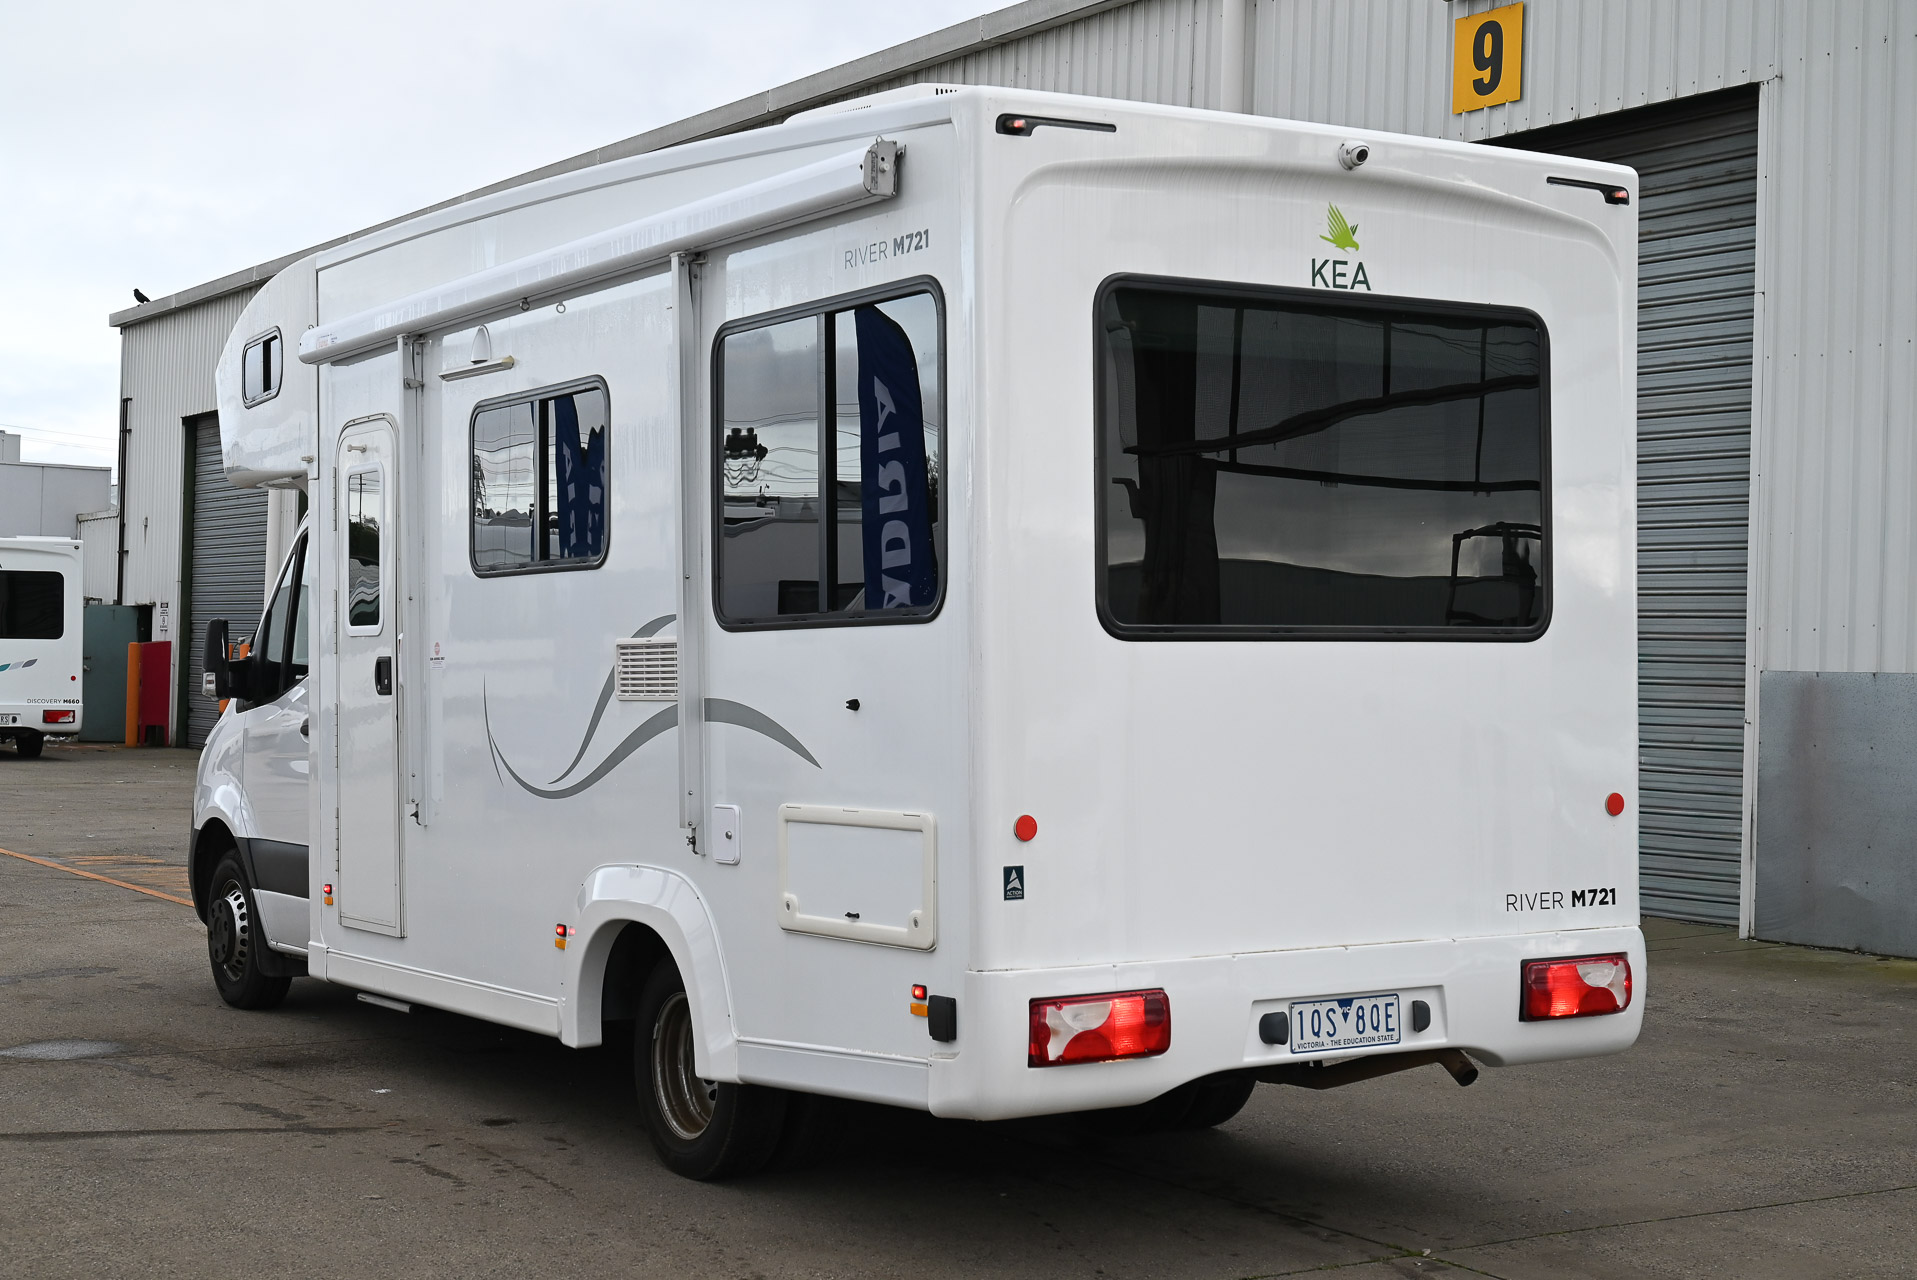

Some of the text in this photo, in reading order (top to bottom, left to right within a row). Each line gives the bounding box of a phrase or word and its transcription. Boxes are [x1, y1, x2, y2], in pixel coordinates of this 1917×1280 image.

[1473, 20, 1503, 96] 9
[844, 228, 929, 270] RIVER M721
[1311, 258, 1371, 291] KEA
[1506, 887, 1617, 912] RIVER M721
[1297, 1002, 1396, 1041] 1QS 8QE
[1297, 1040, 1325, 1050] VICTORIA
[1330, 1039, 1342, 1047] THE
[1343, 1035, 1376, 1046] EDUCATION
[1377, 1033, 1394, 1042] STATE
